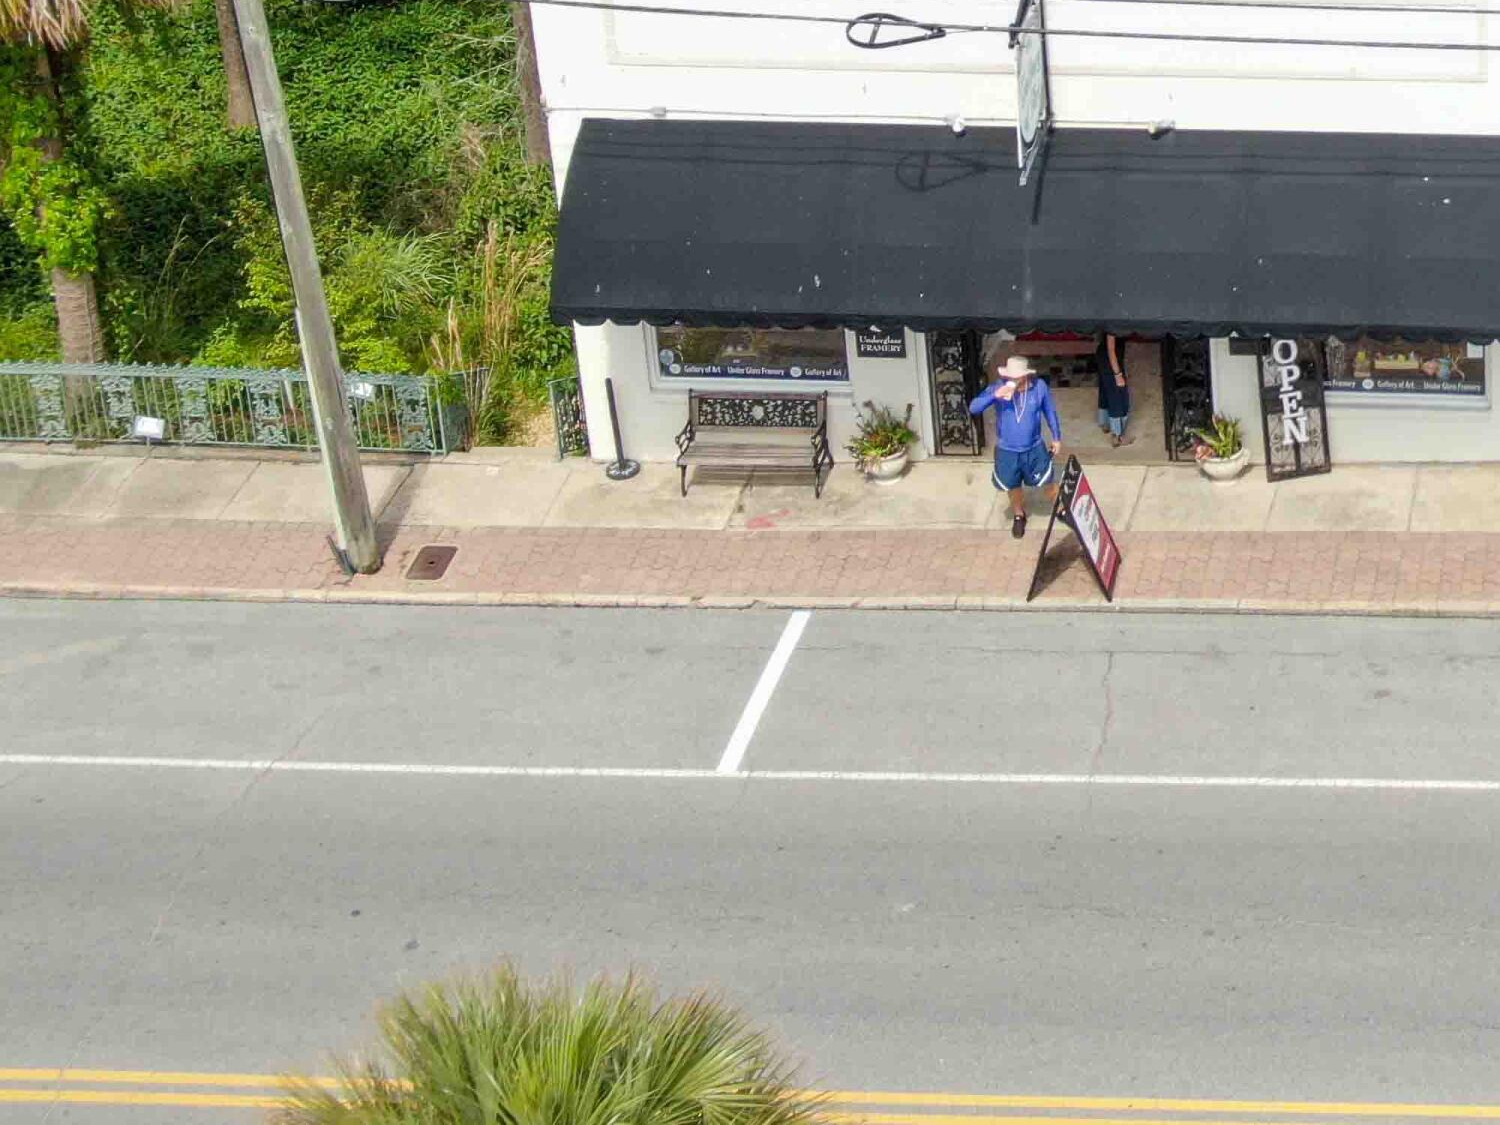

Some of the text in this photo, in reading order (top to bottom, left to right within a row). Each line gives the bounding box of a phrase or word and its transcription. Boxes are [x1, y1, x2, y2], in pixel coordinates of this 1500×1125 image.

[861, 344, 902, 352] FRAMERY
[683, 365, 704, 374] Gallery
[711, 365, 721, 374] Art
[727, 366, 745, 374] Under
[745, 366, 761, 374] Glass
[761, 367, 784, 376] Framery
[805, 368, 825, 377] Gallery
[832, 368, 842, 376] Art
[1376, 380, 1397, 389] Gallery
[1272, 339, 1310, 445] OPEN
